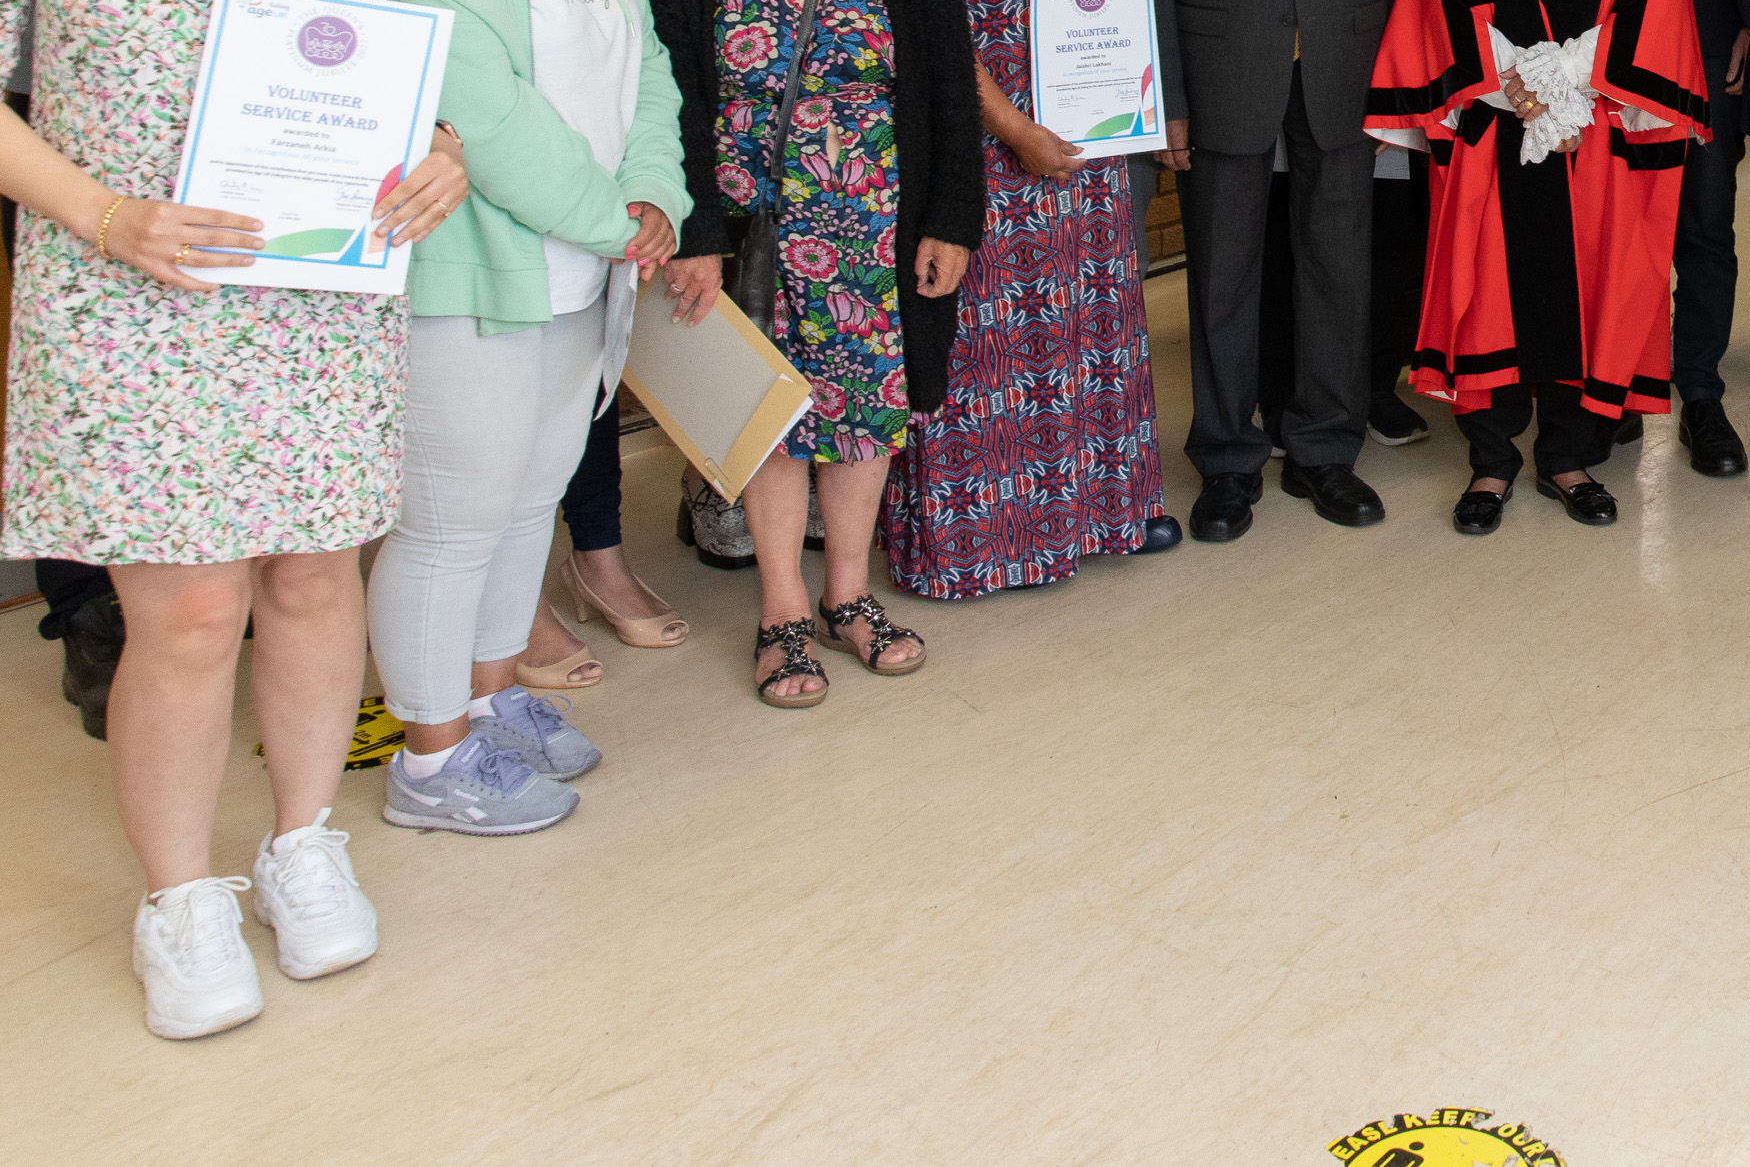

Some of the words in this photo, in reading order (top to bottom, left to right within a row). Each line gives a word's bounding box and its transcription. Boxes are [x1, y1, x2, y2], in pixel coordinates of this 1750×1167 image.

[1066, 27, 1119, 38] VOLUNTEER
[1056, 42, 1094, 53] SERVICE
[1097, 39, 1131, 49] AWARD
[268, 85, 362, 109] VOLUNTEER
[241, 103, 312, 122] SERVICE
[316, 113, 378, 130] AWARD
[1498, 1123, 1545, 1157] OUR
